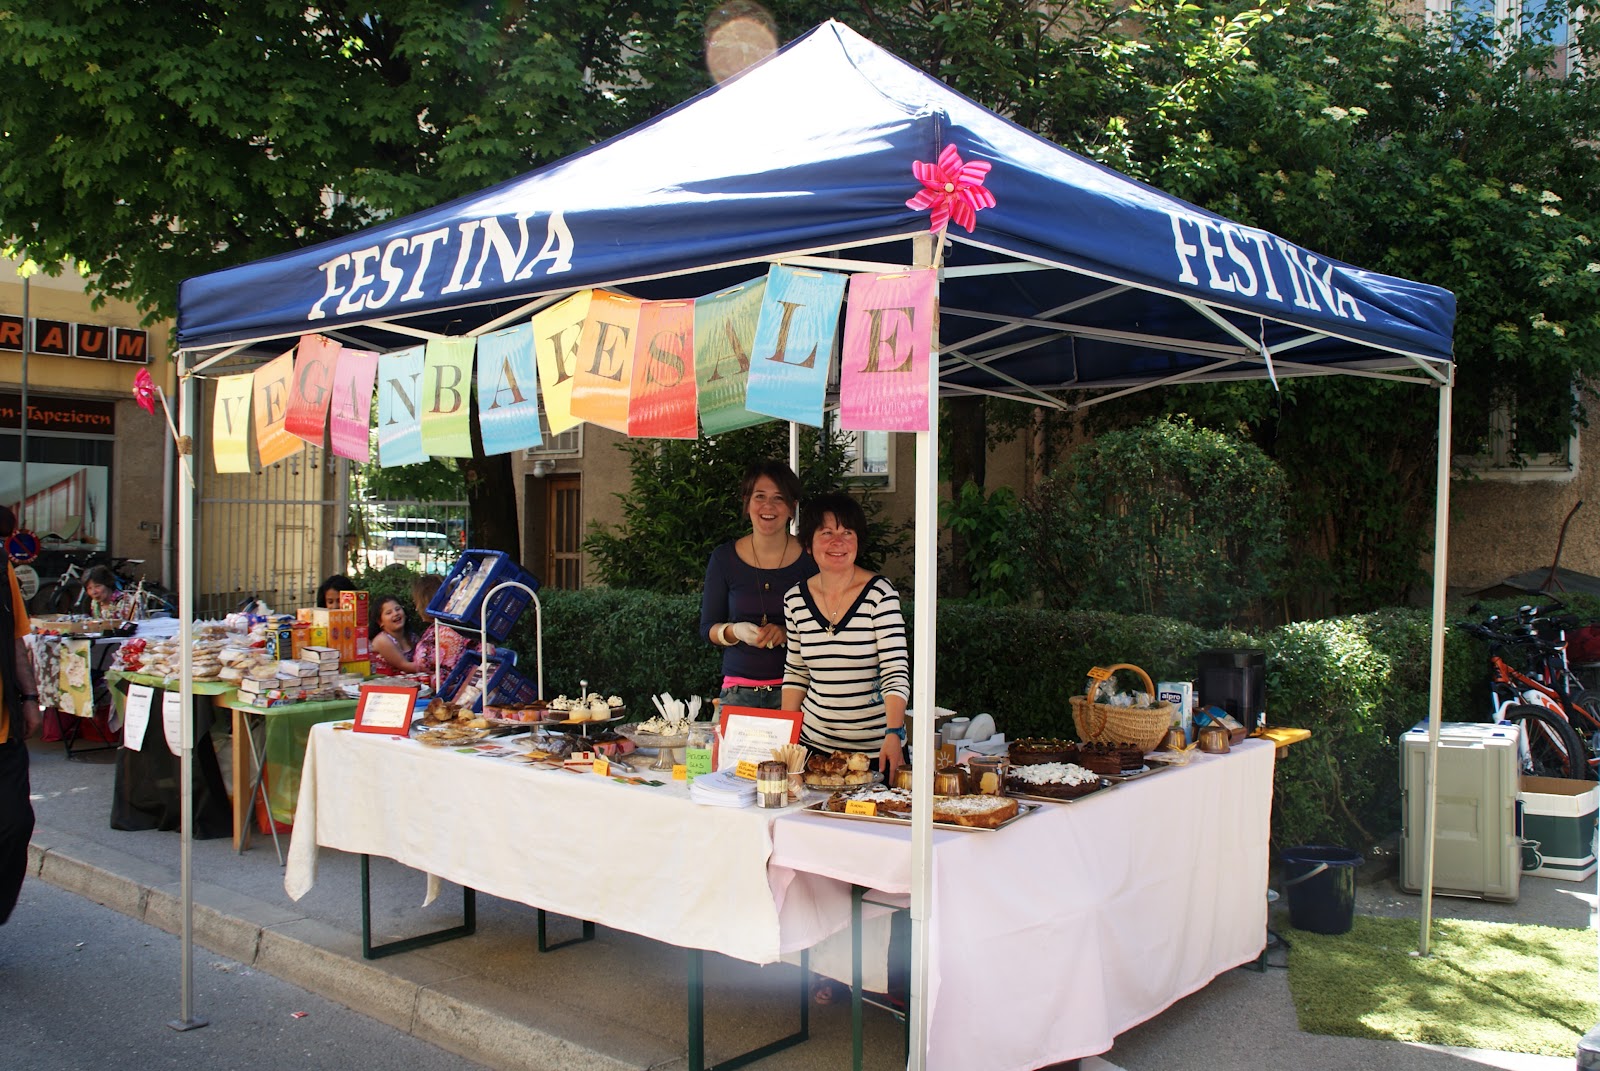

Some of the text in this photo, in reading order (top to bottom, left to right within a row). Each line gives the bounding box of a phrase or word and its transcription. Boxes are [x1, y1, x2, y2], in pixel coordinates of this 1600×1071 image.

[308, 208, 575, 321] FESTINA
[0, 321, 145, 357] RAUM
[26, 405, 112, 425] Tapezieren
[1161, 693, 1181, 701] alpro
